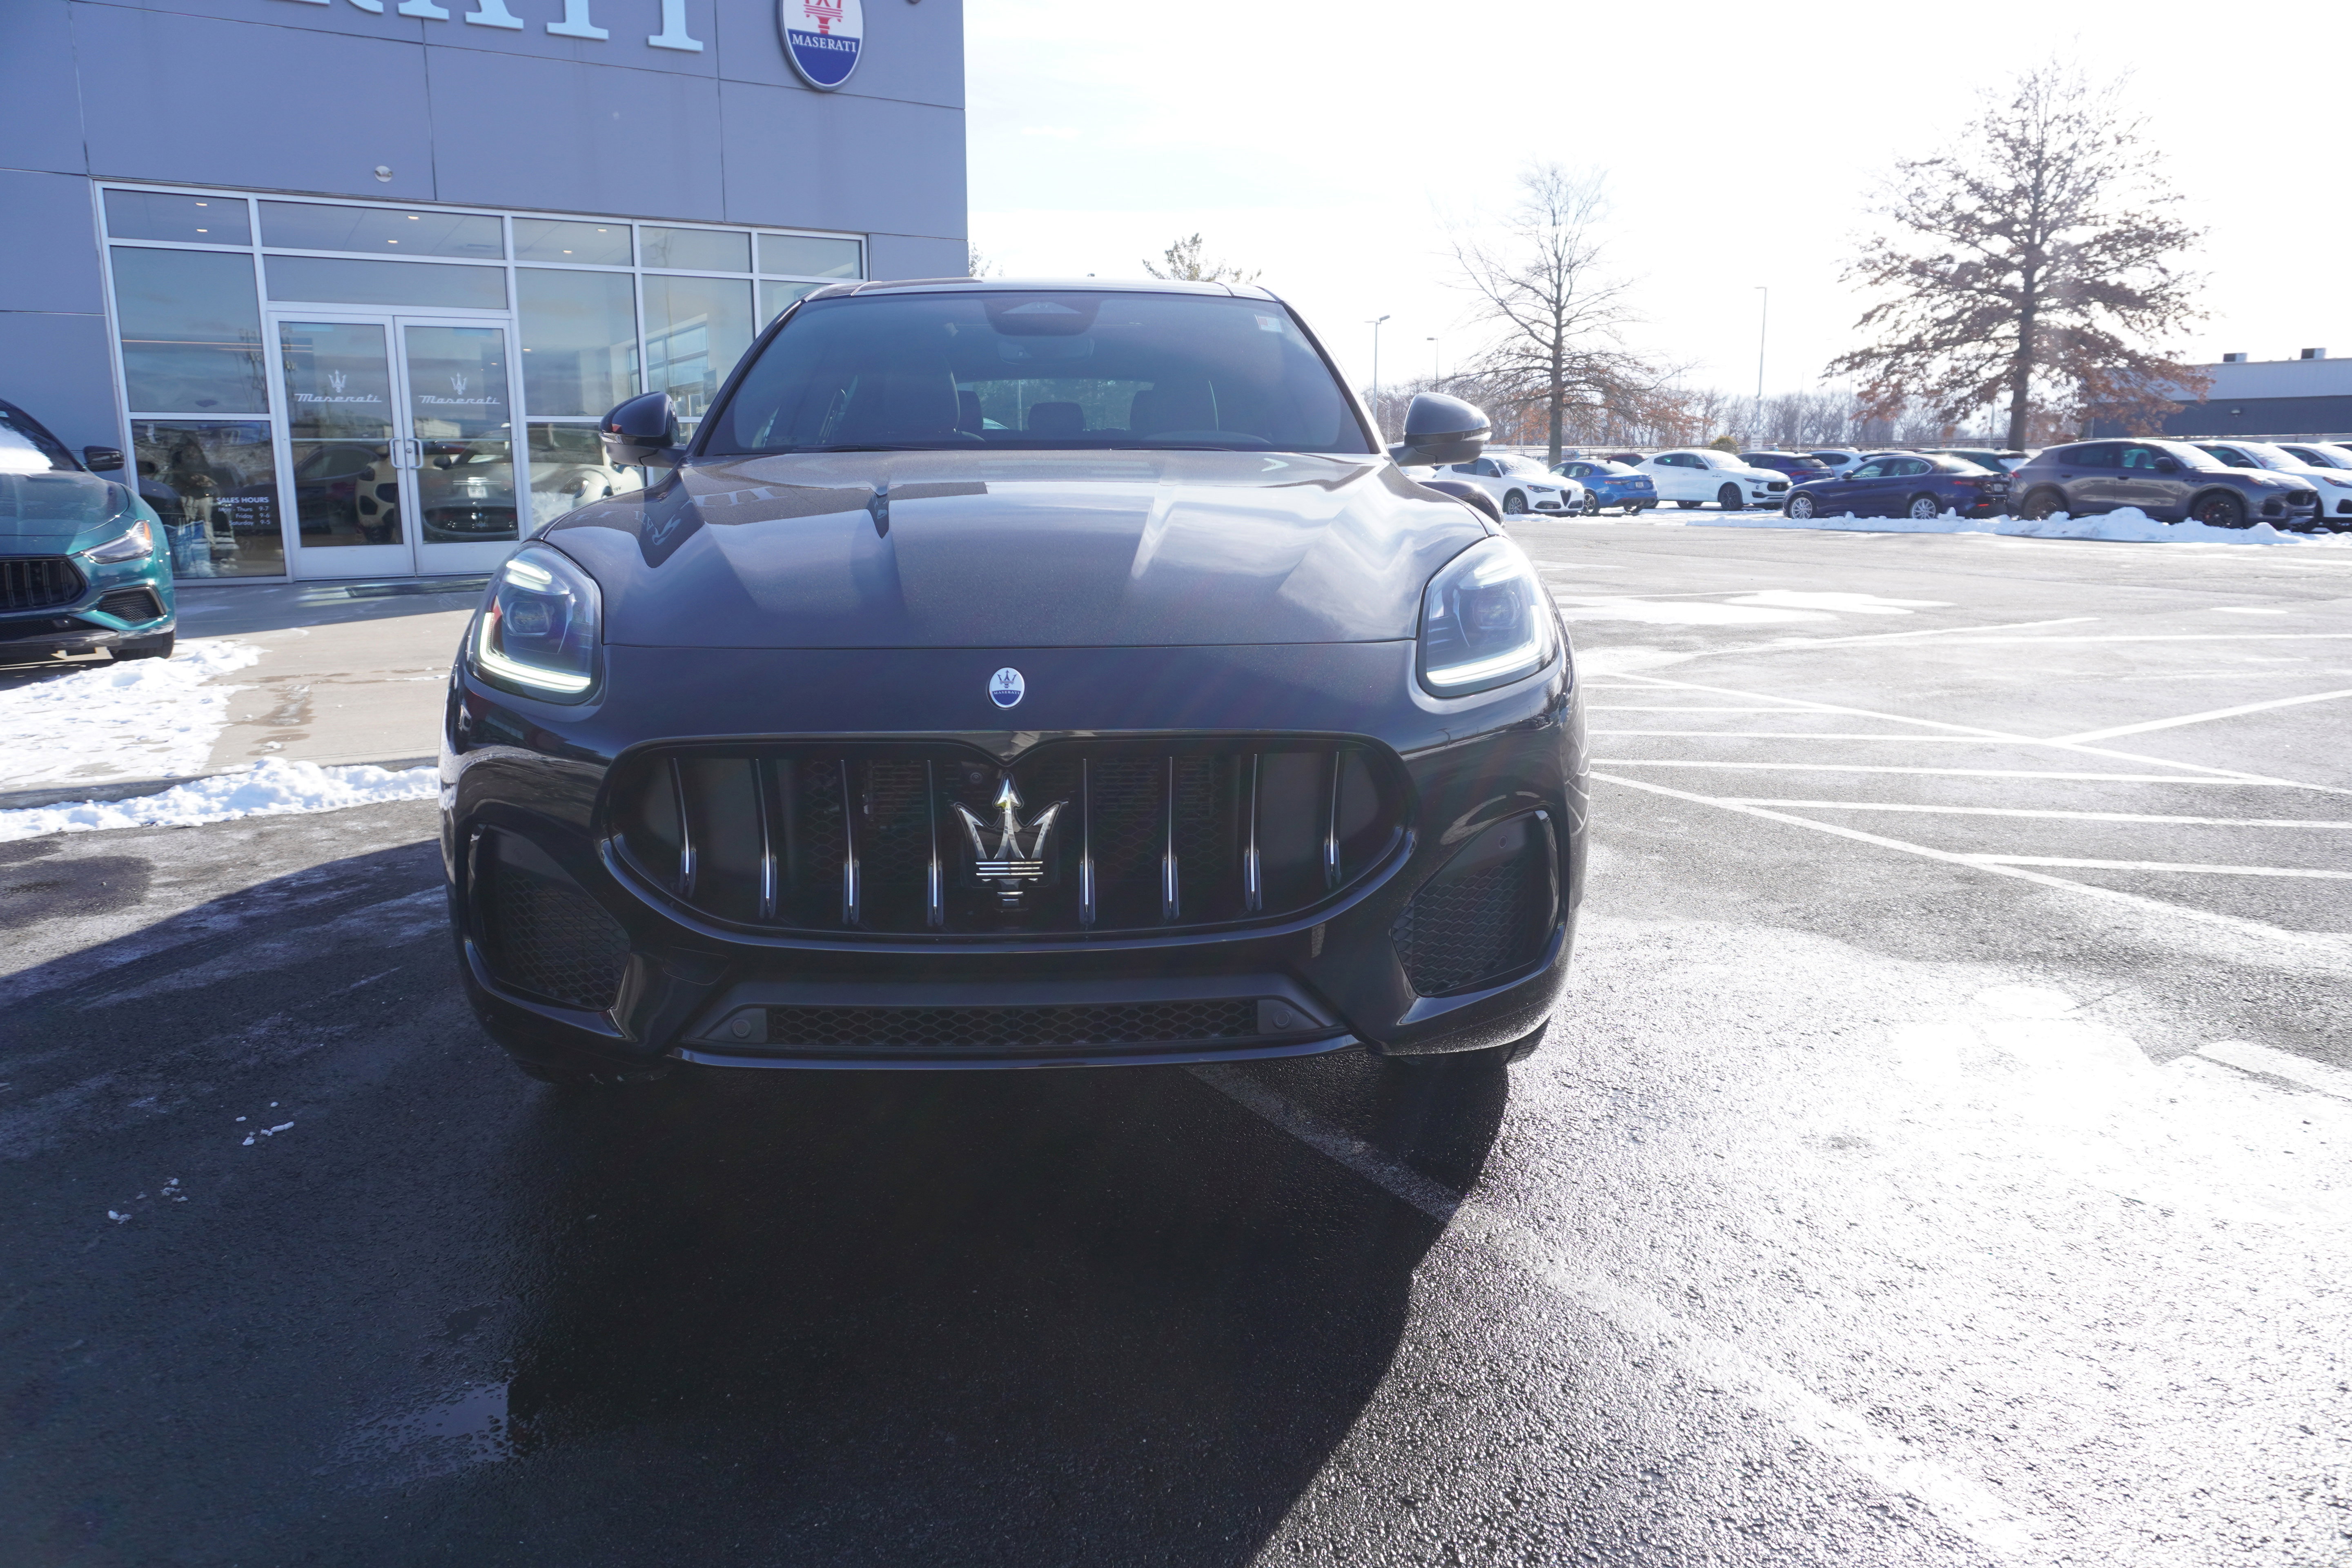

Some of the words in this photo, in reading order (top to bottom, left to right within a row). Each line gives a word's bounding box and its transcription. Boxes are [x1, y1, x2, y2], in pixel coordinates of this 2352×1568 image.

[792, 33, 856, 53] MASERATI
[294, 393, 382, 402] Maserati
[418, 395, 501, 404] Maserati
